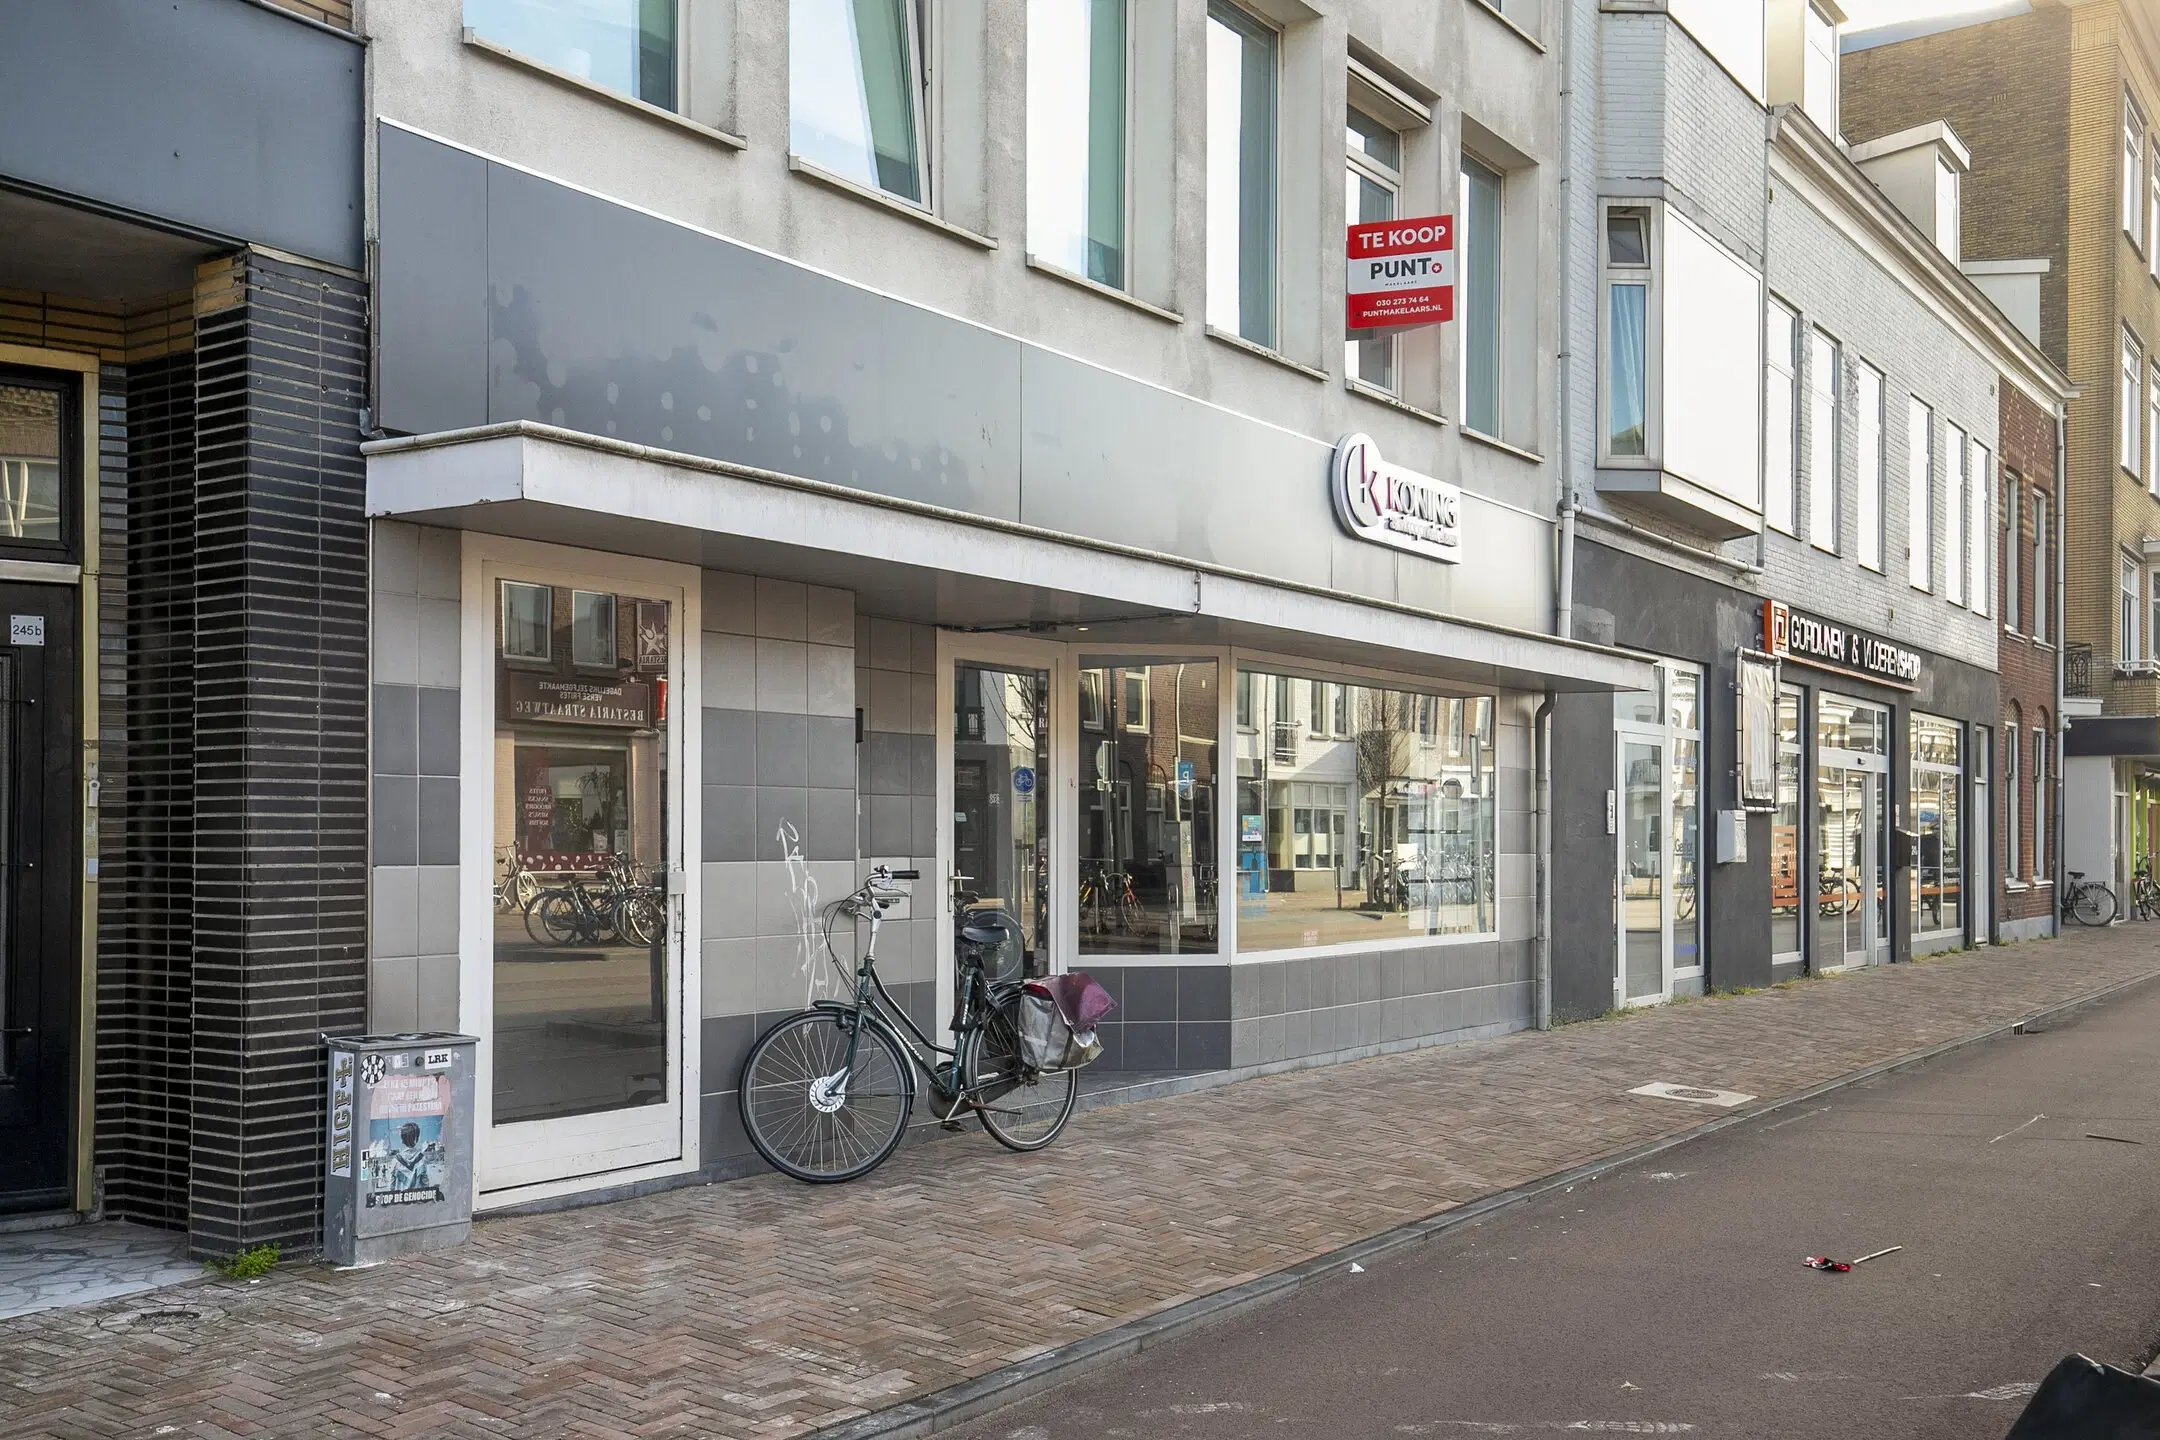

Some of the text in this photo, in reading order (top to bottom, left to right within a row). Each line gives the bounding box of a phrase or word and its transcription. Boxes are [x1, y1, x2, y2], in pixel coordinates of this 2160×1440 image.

[1359, 225, 1446, 249] TE KOOP
[1370, 257, 1432, 280] PUNT
[1363, 304, 1443, 317] PUNTMAKELAARS.NL
[1385, 476, 1457, 528] KONING
[12, 625, 42, 636] 245b
[1851, 633, 1860, 665] &
[428, 1054, 449, 1065] LRK
[394, 1193, 403, 1203] DE
[404, 1190, 437, 1202] GENOCIDE
